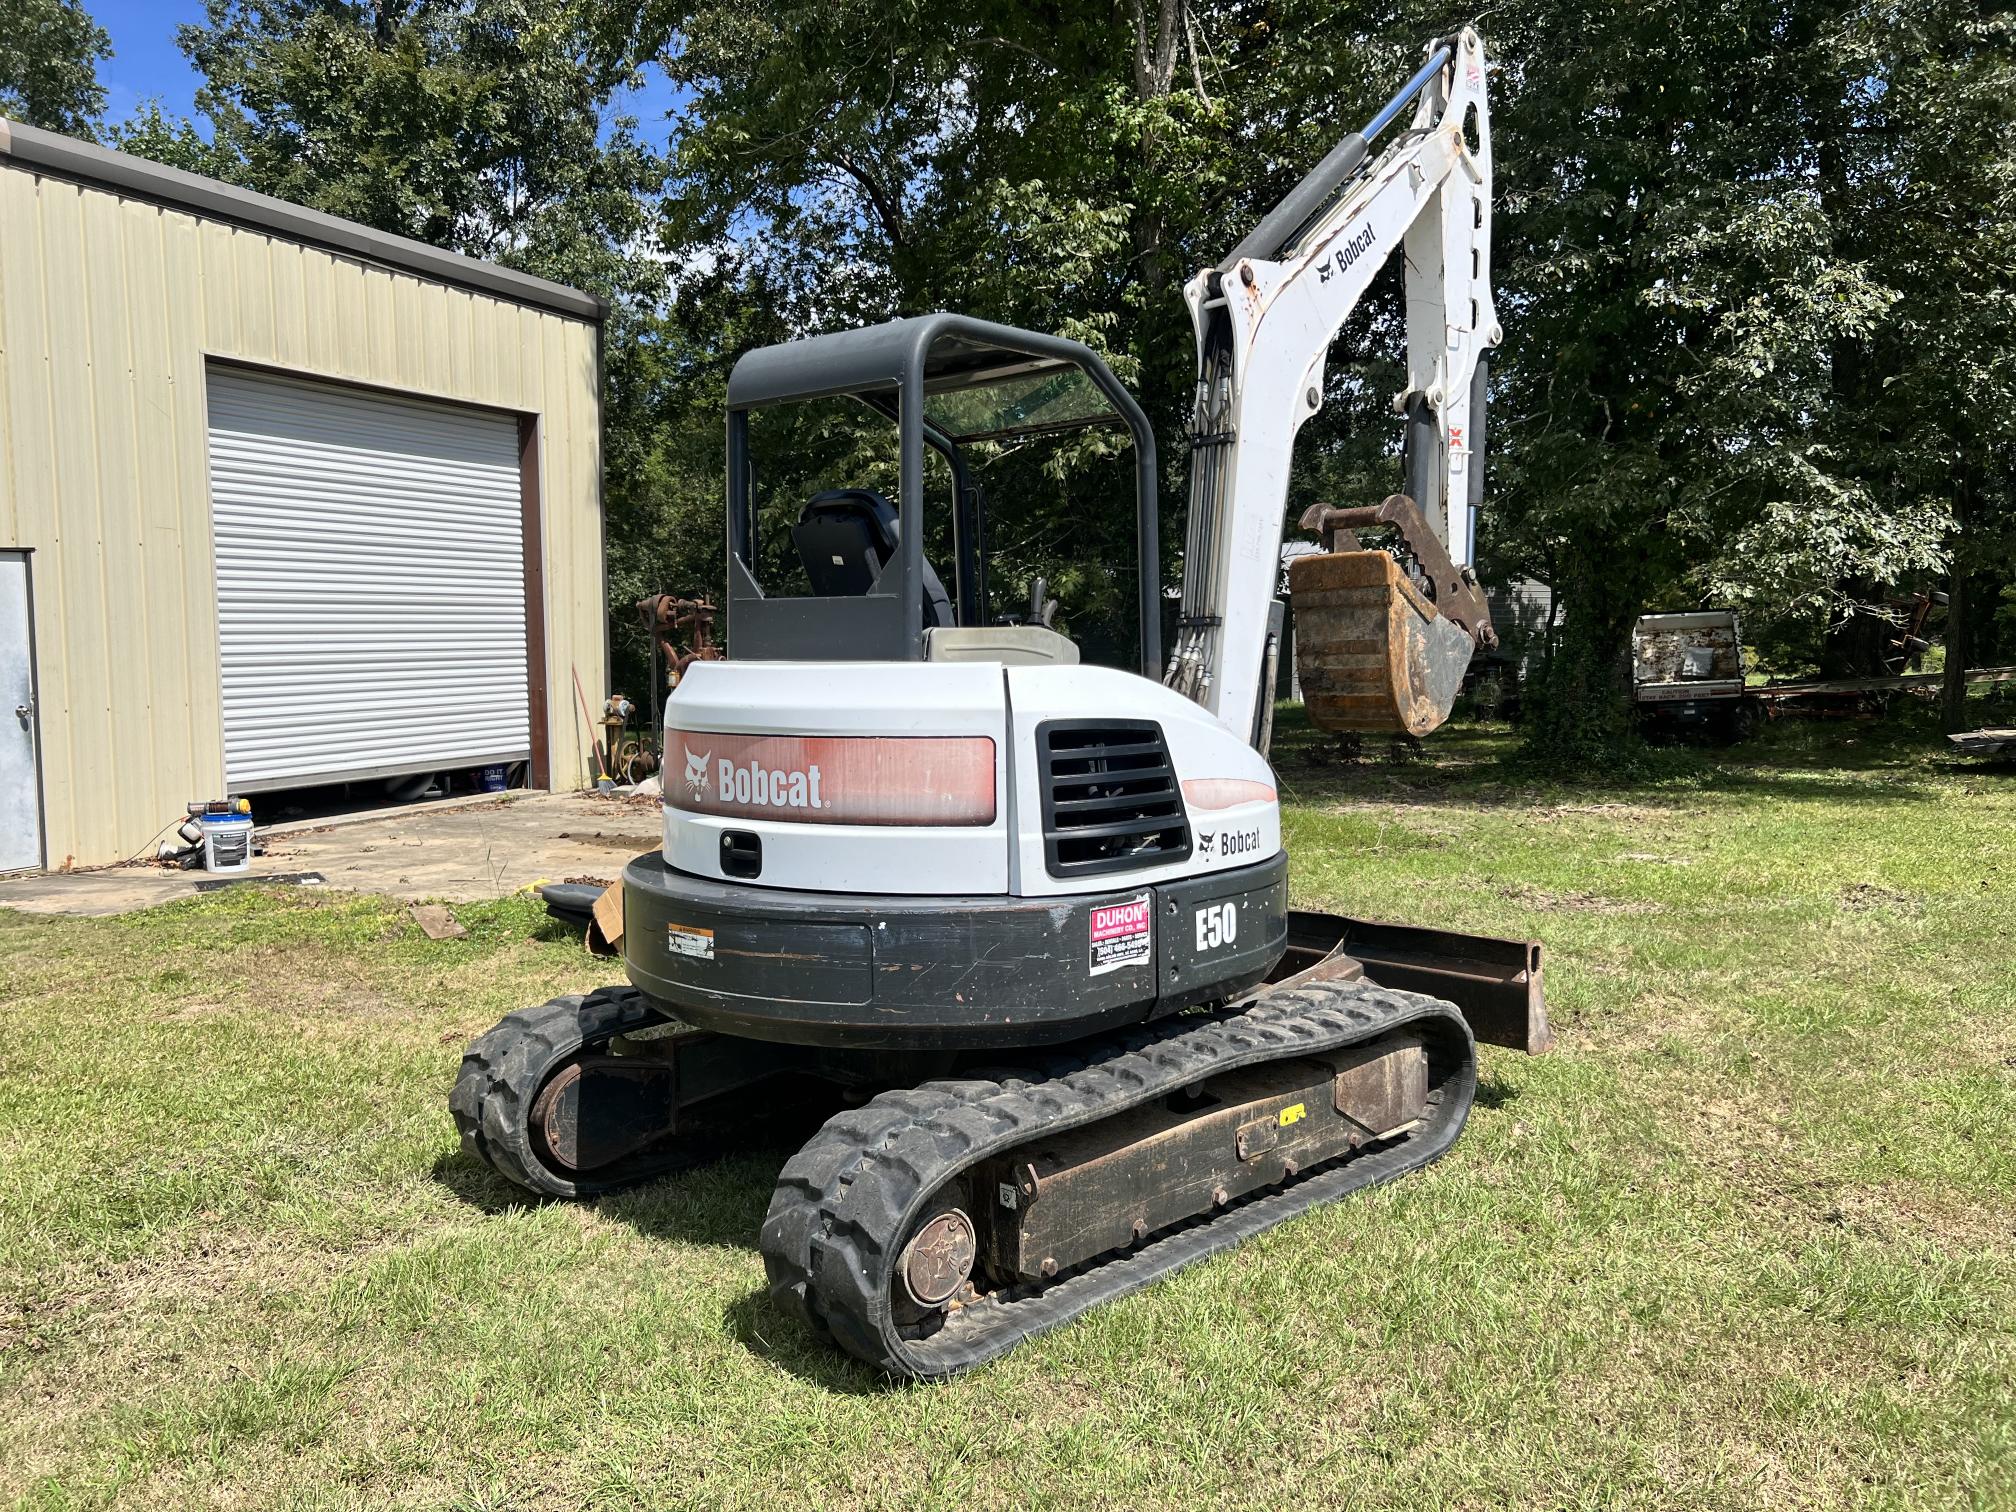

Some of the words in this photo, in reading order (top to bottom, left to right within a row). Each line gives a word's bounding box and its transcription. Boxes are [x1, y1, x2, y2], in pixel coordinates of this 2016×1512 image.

[1335, 221, 1376, 273] Bobcat
[718, 758, 822, 809] Bobcat
[1221, 827, 1260, 856] Bobcat
[1093, 926, 1124, 939] MACHINERY
[1096, 905, 1143, 929] DUHON
[1195, 902, 1236, 952] E50
